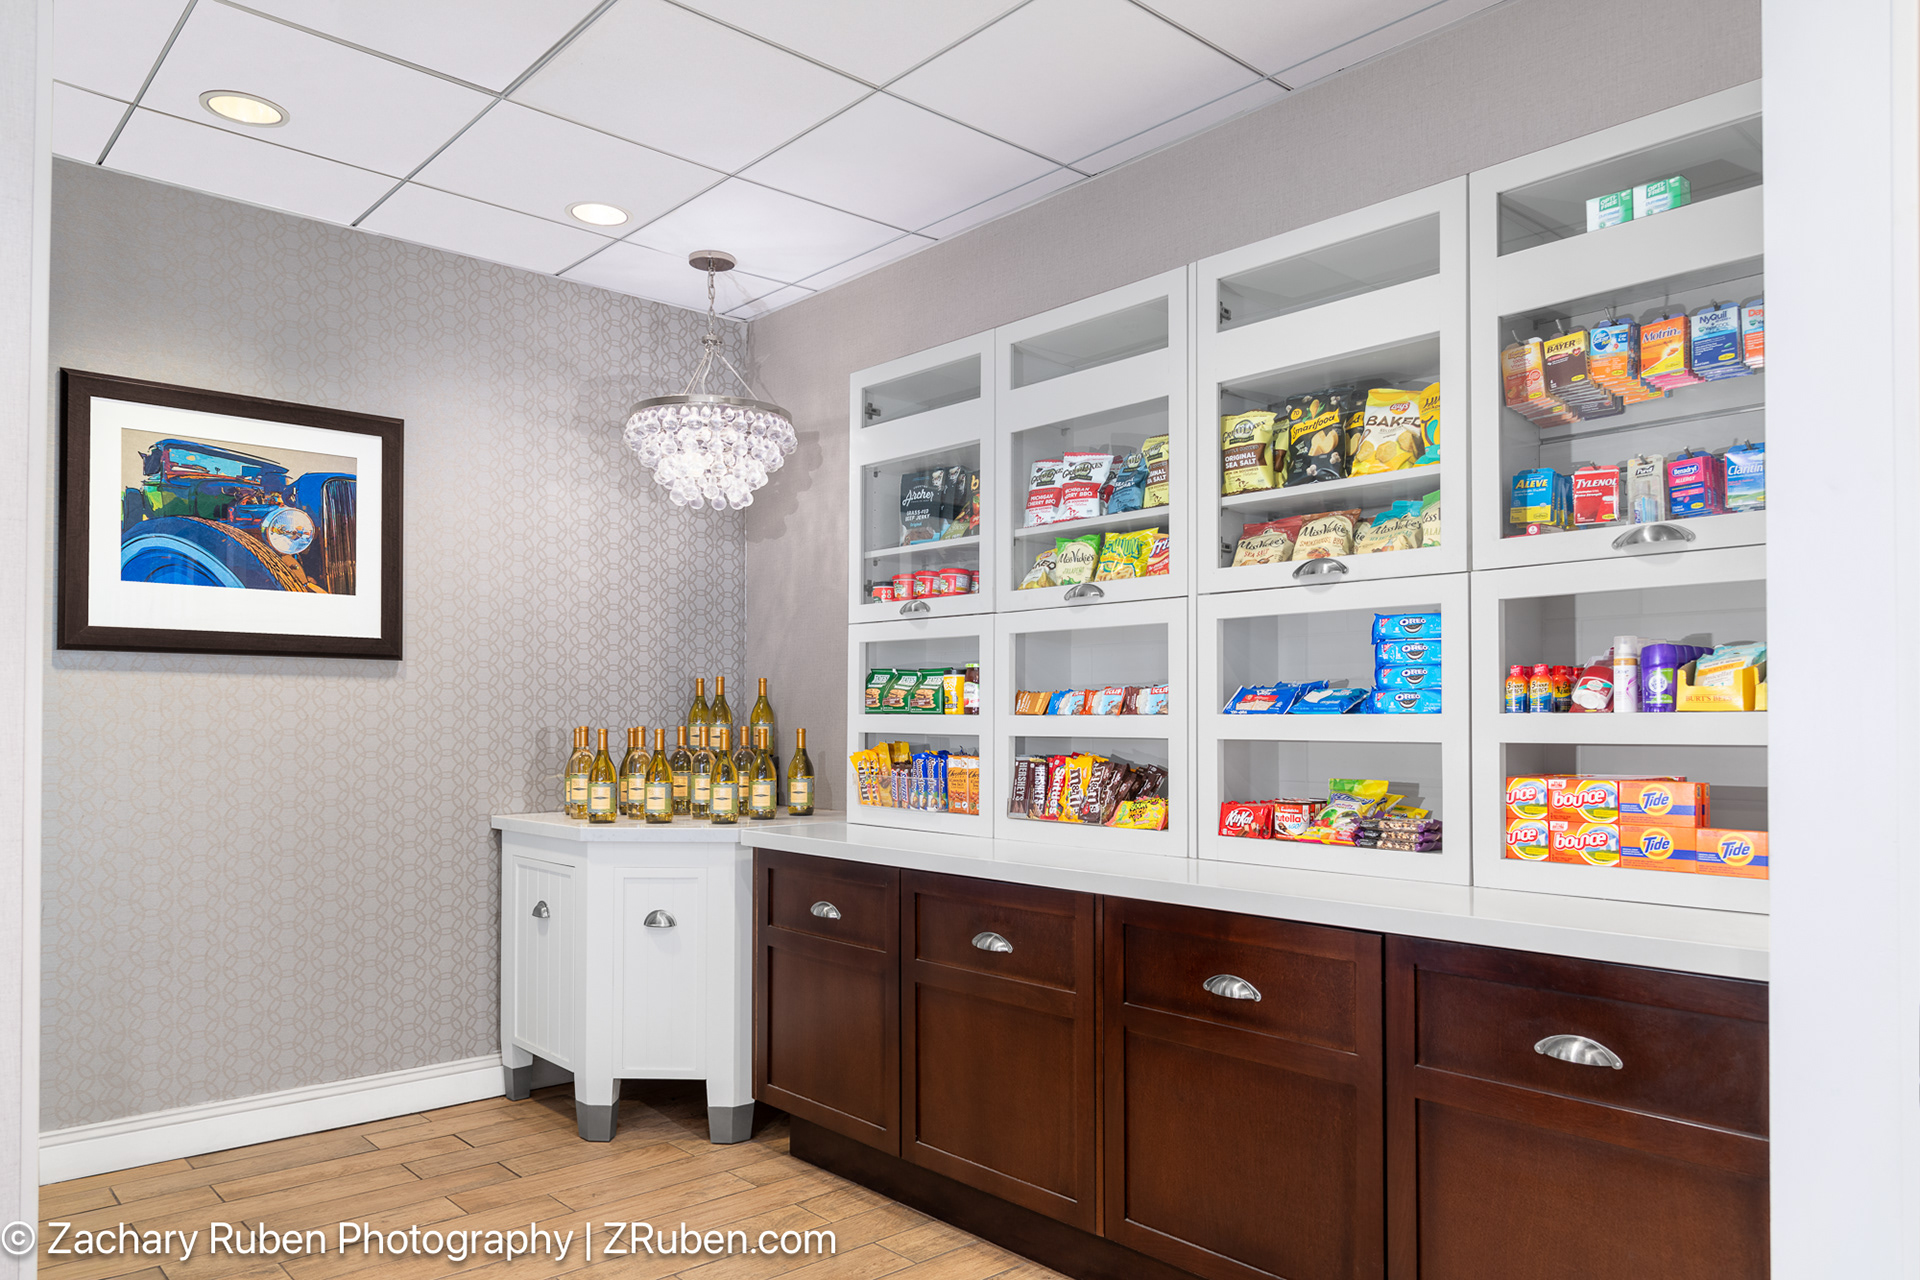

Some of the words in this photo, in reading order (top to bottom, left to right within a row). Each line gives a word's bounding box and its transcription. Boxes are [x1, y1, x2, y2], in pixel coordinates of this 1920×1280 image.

[1647, 187, 1665, 198] FREE
[1600, 200, 1618, 210] FREE
[1699, 310, 1727, 325] NyQuil
[1642, 326, 1677, 344] Motrin
[1547, 339, 1576, 354] BAYER
[1292, 413, 1336, 440] Smartfood
[1366, 415, 1421, 428] BAKED
[1224, 451, 1256, 463] ORIGINAL
[1225, 461, 1238, 469] SEA
[1240, 458, 1256, 467] SALT
[1673, 464, 1698, 475] Benadryl
[1728, 463, 1763, 476] Claritin
[1153, 474, 1167, 482] SALT
[1576, 478, 1617, 489] TYLENOL
[1675, 476, 1696, 484] ALLERGY
[1515, 479, 1548, 490] ALEVE
[902, 488, 934, 507] Archer
[1300, 526, 1323, 537] Miss
[1399, 616, 1426, 626] OREO
[1401, 643, 1428, 653] OREO
[1401, 669, 1428, 677] OREO
[1395, 692, 1421, 701] OREO
[1049, 767, 1065, 814] Skittles
[1553, 789, 1606, 809] bounce
[1643, 791, 1670, 809] Tide
[1555, 831, 1608, 850] bounce
[1643, 836, 1670, 853] Tide
[1721, 841, 1751, 859] Tide
